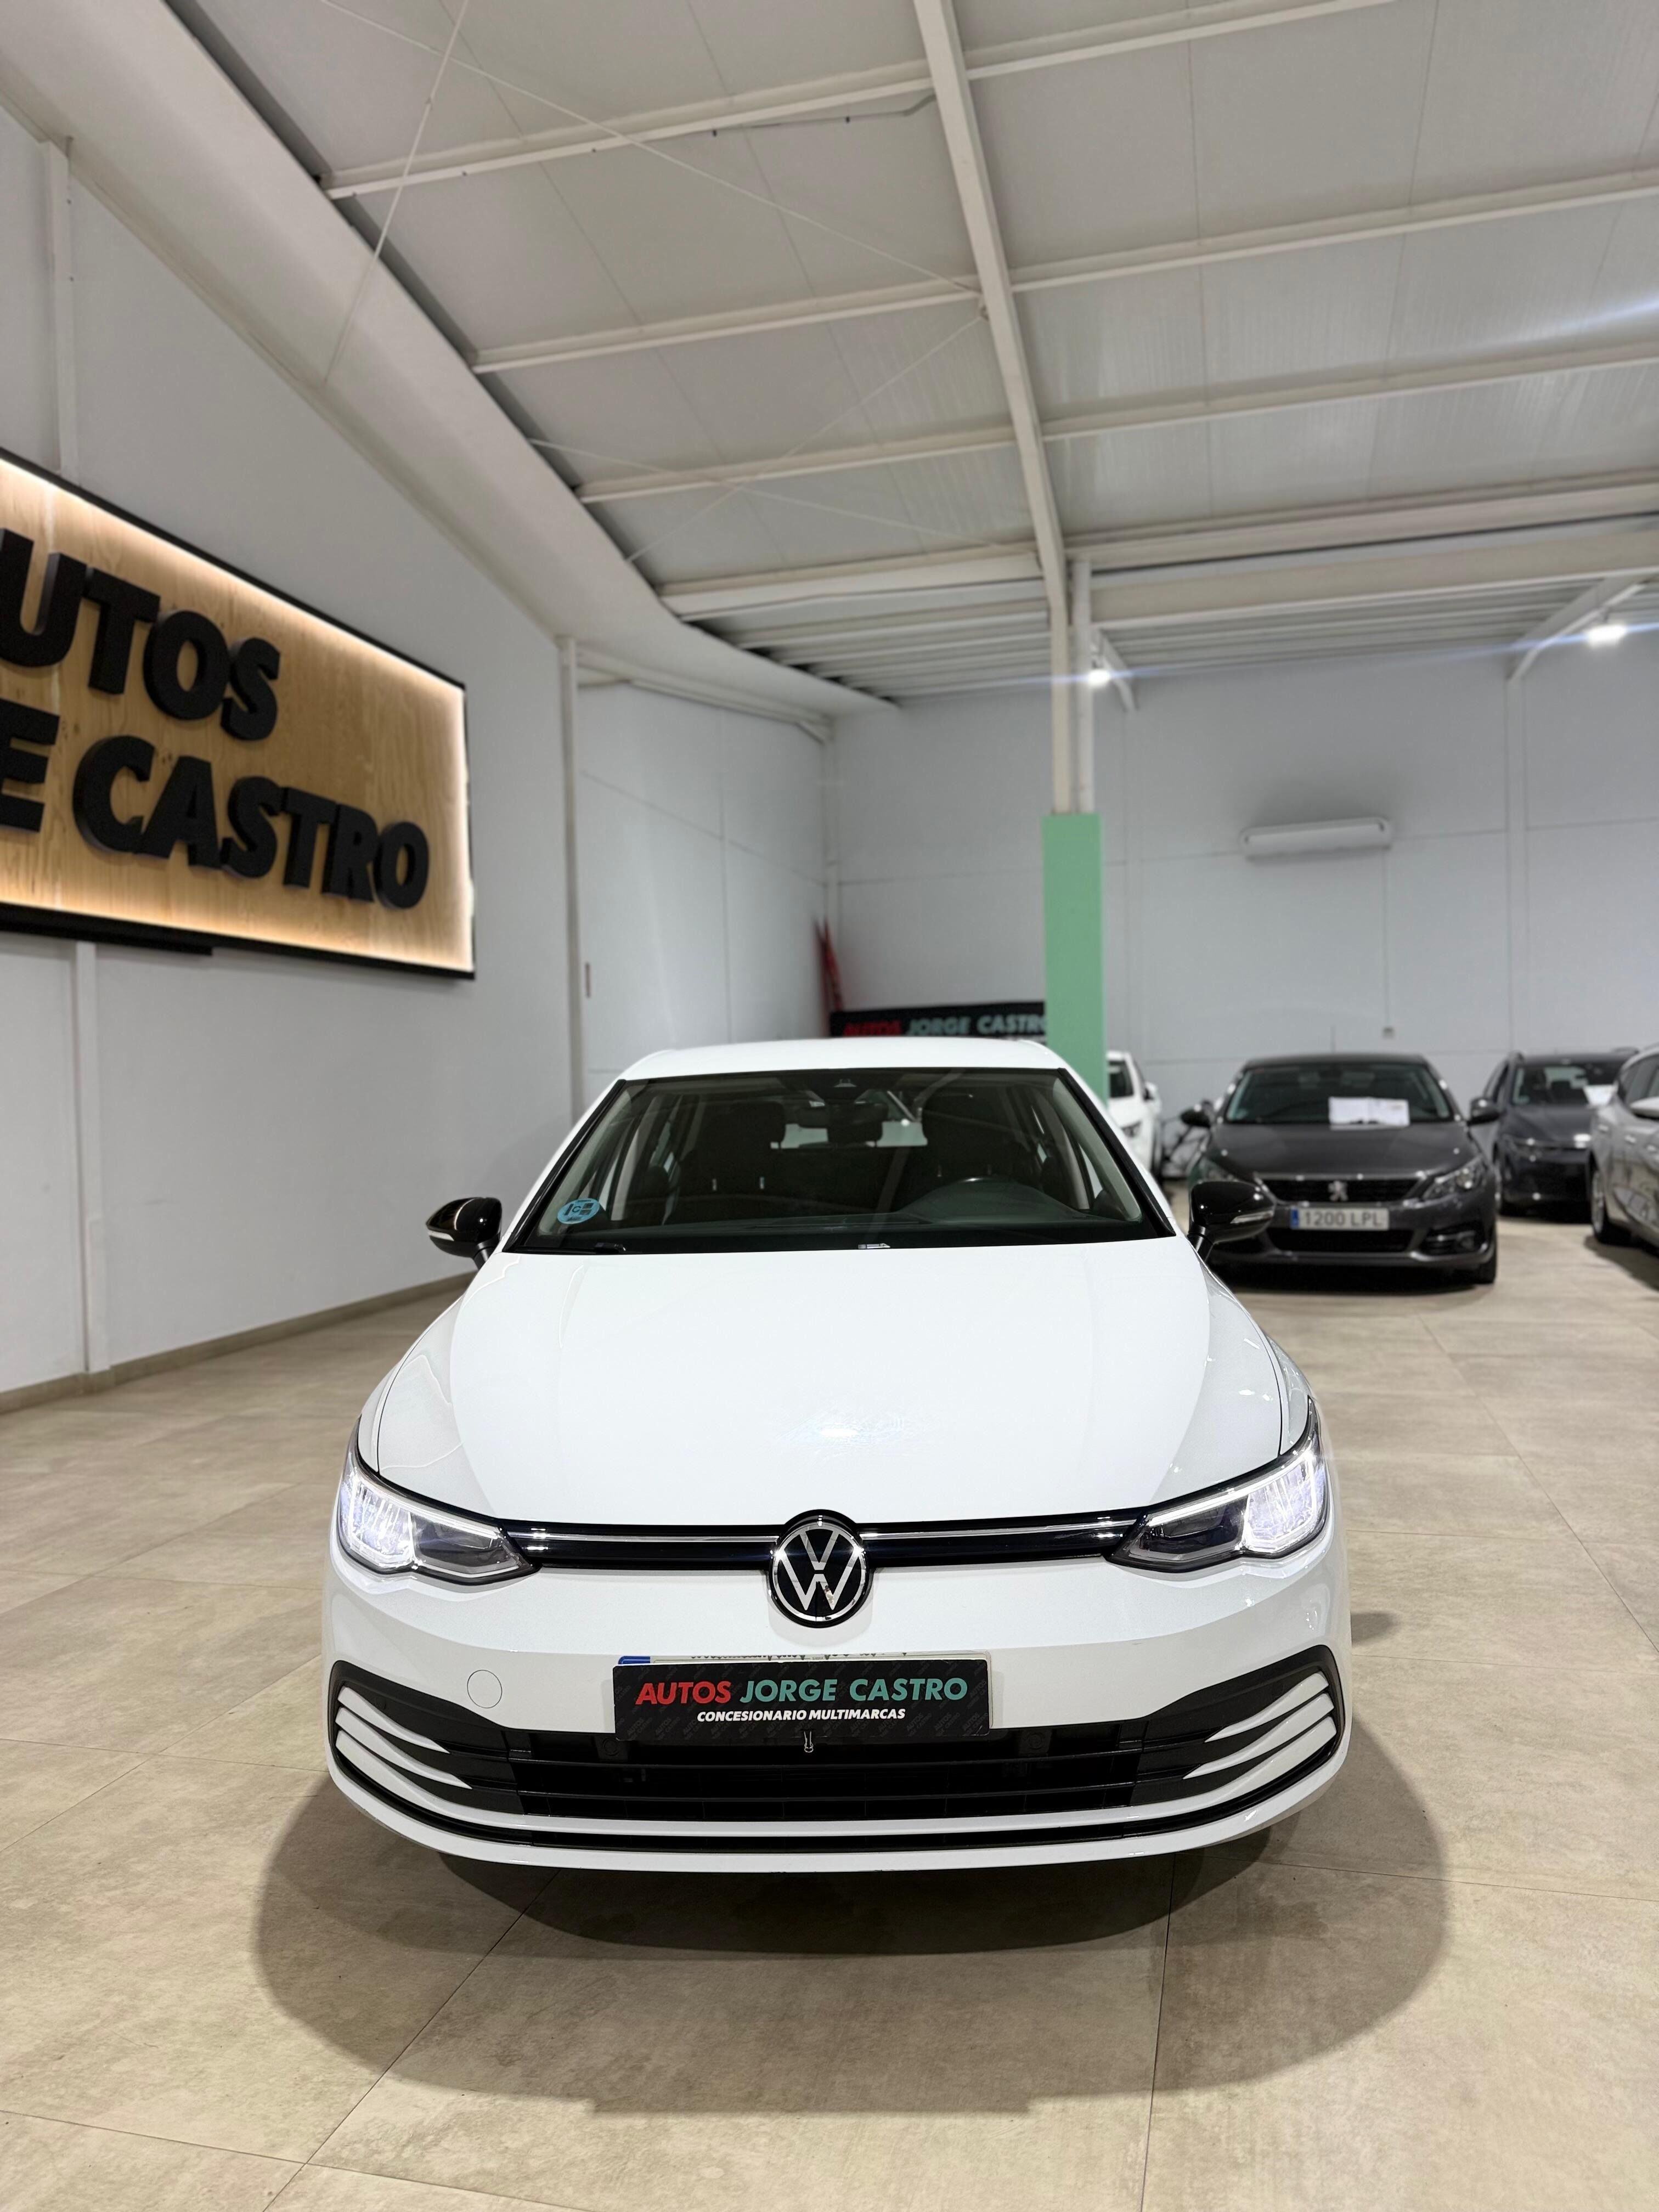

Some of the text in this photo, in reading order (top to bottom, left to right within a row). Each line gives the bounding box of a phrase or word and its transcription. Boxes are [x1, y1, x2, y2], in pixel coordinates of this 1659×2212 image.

[72, 735, 429, 909] CASTRO
[906, 1017, 971, 1035] JORGE
[1305, 1211, 1383, 1226] 1200 LPL
[635, 1678, 967, 1705] AUTOS JORGE CASTRO
[697, 1709, 905, 1722] CONCESIONARIO MULTIMARCAS
